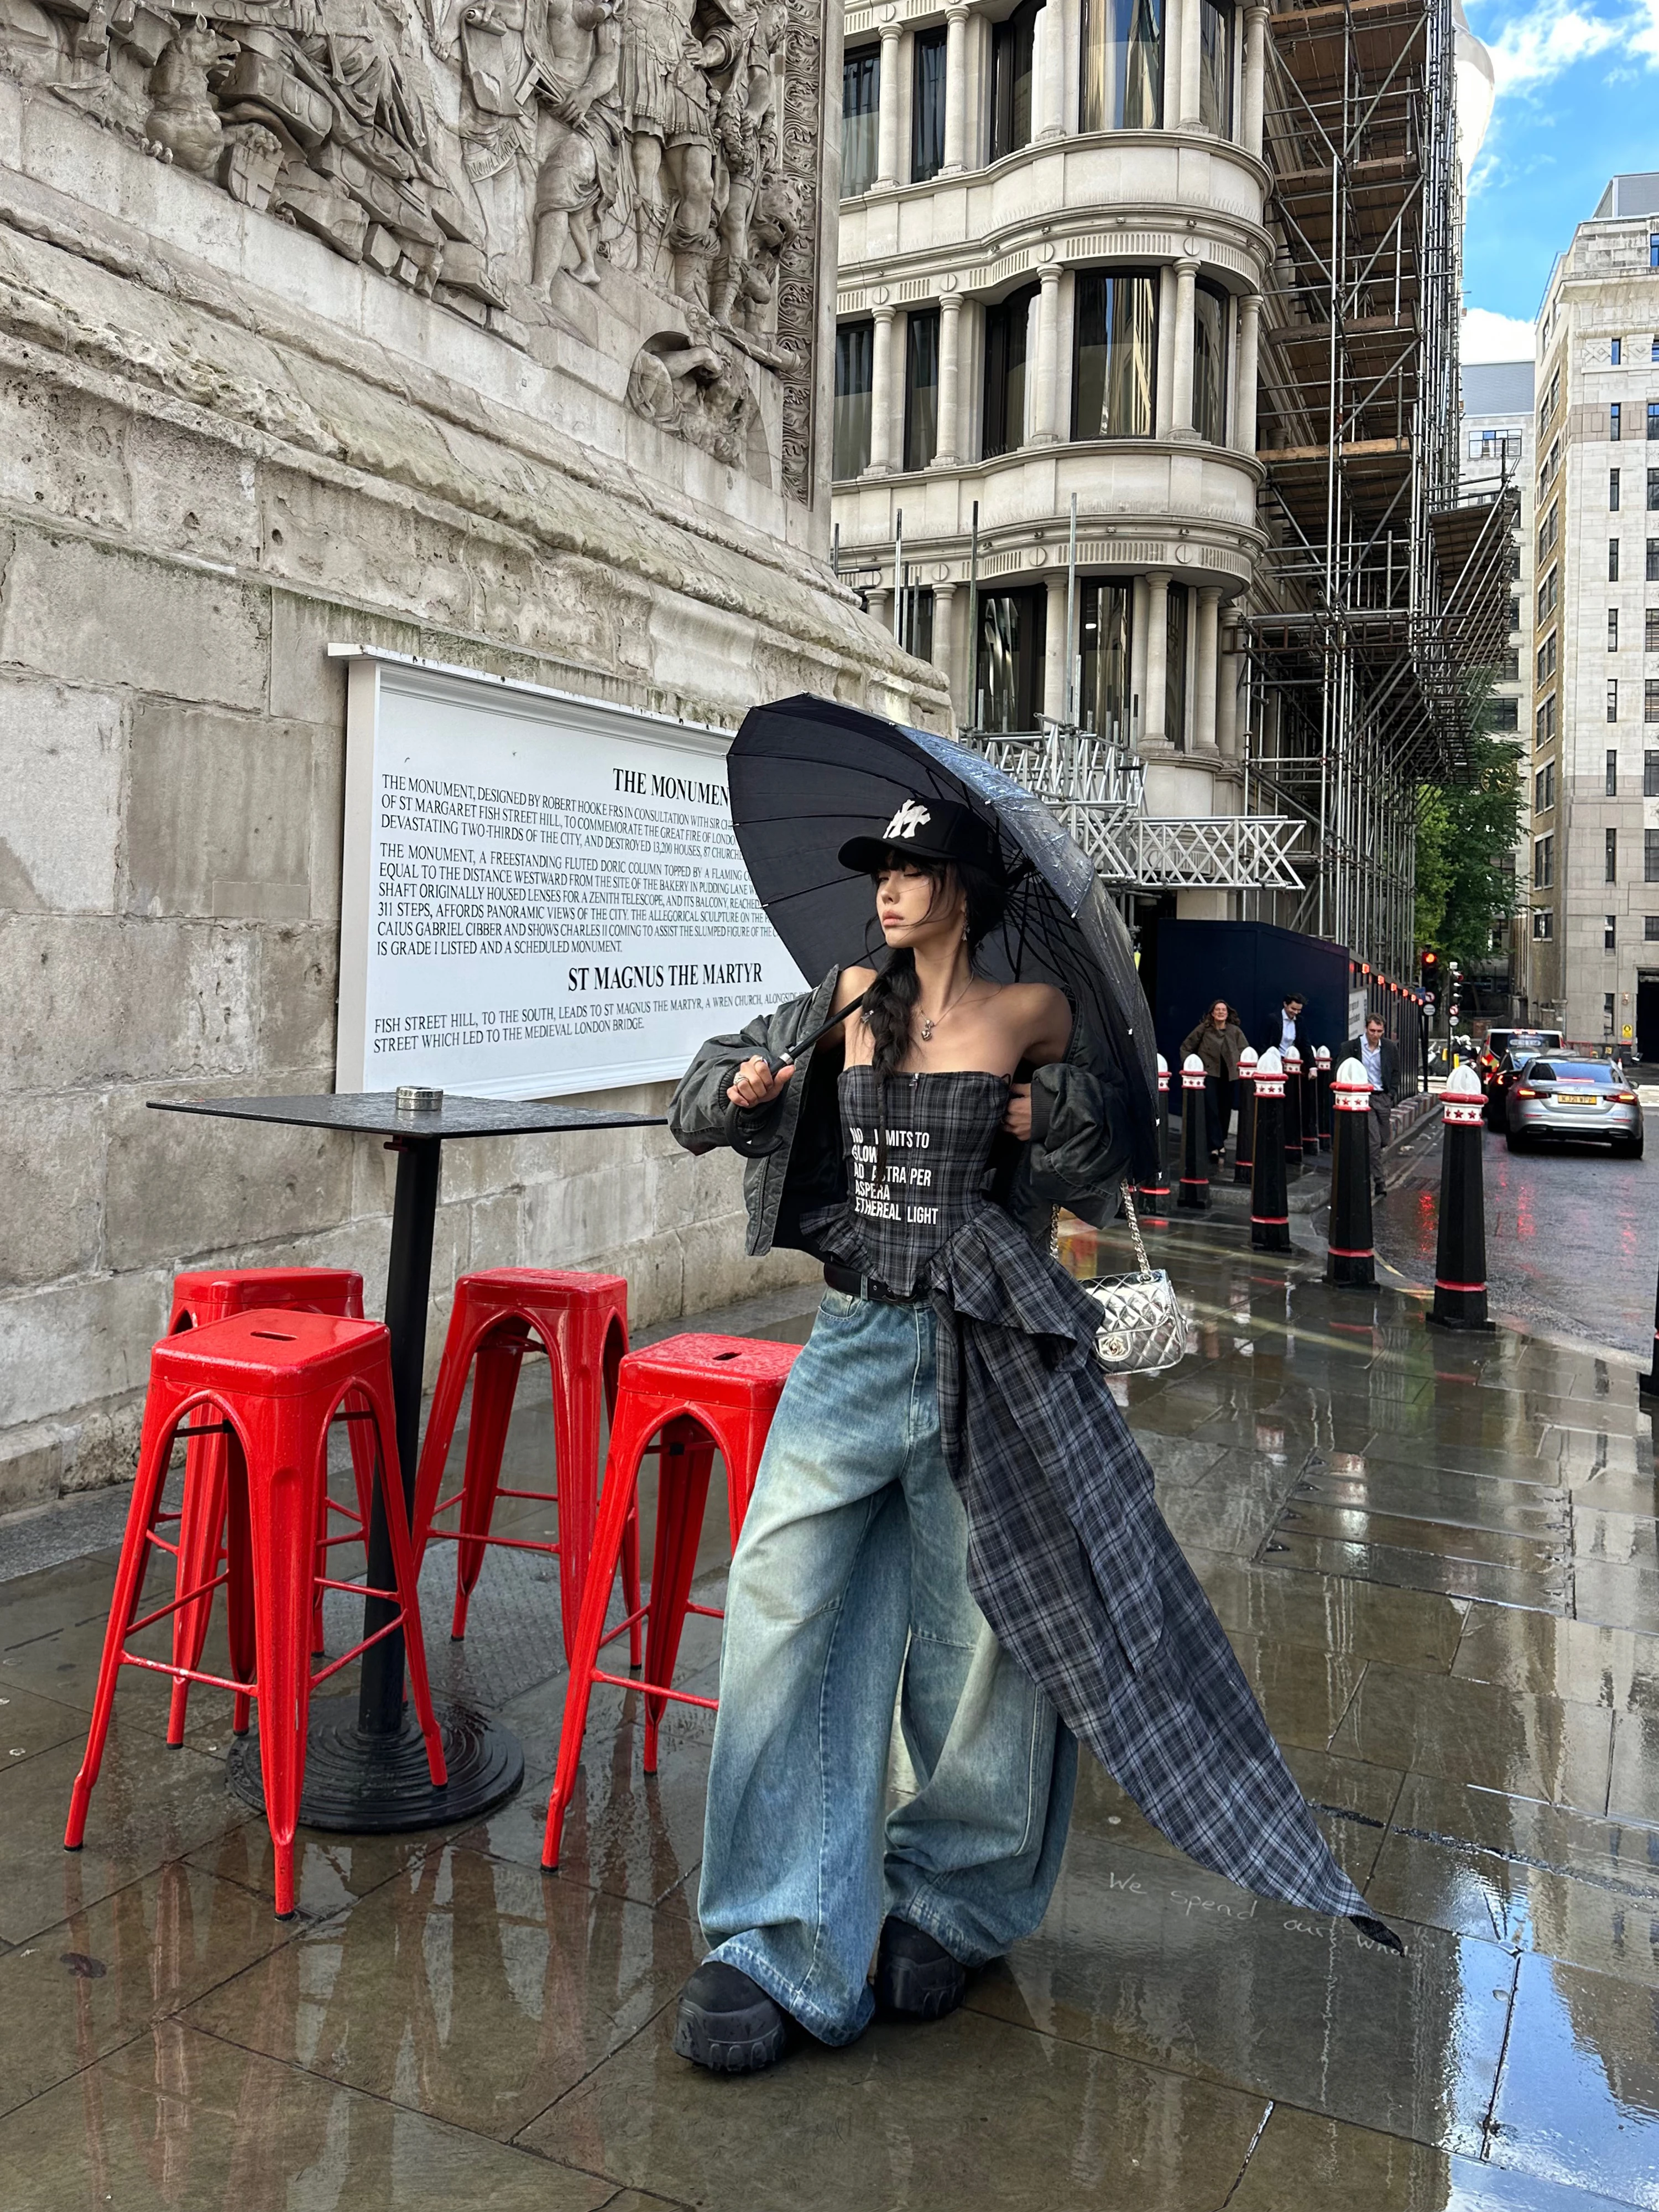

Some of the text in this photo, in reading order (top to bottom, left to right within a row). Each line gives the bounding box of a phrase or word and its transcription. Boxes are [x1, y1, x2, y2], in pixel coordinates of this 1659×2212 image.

[613, 769, 647, 795] THE
[382, 774, 406, 791] THE
[408, 777, 476, 801] MONUMENT,
[477, 786, 527, 805] DESIGNED
[528, 793, 540, 807] BY
[542, 795, 576, 811] ROBERT
[577, 799, 608, 815] HOOKE
[608, 803, 624, 817] FRS
[624, 805, 633, 818] IN
[634, 806, 689, 825] CONSULTATION
[690, 813, 709, 827] WITH
[709, 816, 720, 828] SIR
[381, 794, 737, 846] OF ST MARGARET FISH STREET HILL, TO COMMEMORATE THE GREAT FIRE OF LONDO
[381, 813, 458, 834] DEVASTATING
[461, 822, 524, 841] TWO-THIRDS
[525, 828, 538, 842] OF
[540, 830, 559, 843] THE
[560, 832, 582, 847] CITY,
[584, 834, 604, 848] AND
[604, 836, 651, 852] DESTROYED
[653, 841, 672, 855] 13,200
[674, 843, 702, 858] HOUSES,
[703, 846, 711, 857] 87
[379, 843, 404, 858] THE
[408, 845, 476, 865] MONUMENT,
[479, 851, 487, 864] A
[490, 852, 562, 869] FREESTANDING
[564, 857, 598, 871] FLUTED
[600, 860, 626, 873] DORIC
[628, 862, 662, 875] COLUMN
[664, 865, 691, 877] TOPPED
[692, 867, 702, 878] BY
[705, 868, 710, 878] A
[711, 868, 742, 880] FLAMING
[379, 862, 419, 880] EQUAL
[420, 865, 437, 879] TO
[438, 866, 461, 880] THE
[462, 867, 512, 883] DISTANCE
[514, 870, 568, 885] WESTWARD
[568, 874, 593, 887] FROM
[594, 875, 612, 888] THE
[612, 877, 630, 889] SITE
[630, 878, 641, 889] OF
[643, 878, 658, 890] THE
[659, 879, 688, 891] BAKERY
[690, 881, 698, 892] IN
[698, 881, 729, 894] PUDDING
[730, 884, 748, 895] LANE
[378, 883, 417, 898] SHAFT
[419, 884, 484, 900] ORIGINALLY
[487, 887, 526, 901] HOUSED
[528, 889, 561, 902] LENSES
[562, 890, 580, 903] FOR
[581, 891, 588, 903] A
[588, 891, 619, 904] ZENITH
[620, 893, 665, 907] TELESCOPE,
[666, 895, 683, 906] AND
[684, 896, 695, 907] ITS
[695, 896, 729, 910] BALCONY,
[377, 901, 393, 916] 311
[397, 902, 433, 919] STEPS,
[436, 903, 484, 918] AFFORDS
[487, 905, 545, 919] PANORAMIC
[546, 906, 575, 919] VIEWS
[577, 907, 588, 919] OF
[590, 907, 608, 920] THE
[608, 908, 629, 920] CITY.
[630, 909, 647, 920] THE
[648, 909, 699, 921] ALLEGORICAL
[700, 911, 739, 922] SCULPTURE
[740, 912, 750, 922] ON
[751, 912, 763, 922] THE
[377, 921, 413, 936] CAIUS
[415, 922, 464, 936] GABRIEL
[465, 923, 502, 936] CIBBER
[504, 924, 526, 936] AND
[527, 924, 559, 936] SHOWS
[560, 924, 601, 937] CHARLES
[602, 925, 607, 937] II
[608, 925, 641, 937] COMING
[642, 925, 654, 937] TO
[654, 925, 678, 937] ASSIST
[679, 926, 693, 937] THE
[694, 926, 727, 937] SLUMPED
[726, 926, 750, 937] FIGURE
[750, 927, 759, 937] OF
[760, 927, 772, 937] THE
[377, 941, 623, 956] IS GRADE I LISTED AND A SCHEDULED MONUMENT.
[567, 962, 762, 992] ST MAGNUS THE MARTYR
[374, 1017, 400, 1033] FISH
[404, 1014, 447, 1031] STREET
[450, 1012, 478, 1029] HILL,
[481, 1011, 496, 1025] TO
[498, 1010, 519, 1024] THE
[521, 1008, 556, 1024] SOUTH,
[559, 1005, 588, 1020] LEADS
[589, 1005, 602, 1018] TO
[604, 1004, 614, 1016] ST
[616, 1001, 651, 1015] MAGNUS
[654, 1001, 668, 1013] THE
[670, 999, 703, 1013] MARTYR,
[706, 998, 711, 1009] A
[712, 997, 733, 1008] WREN
[734, 995, 763, 1008] CHURCH,
[373, 1017, 644, 1053] STREET WHICH LED TO THE MEDIEVAL LONDON BRIDGE.
[849, 1128, 863, 1144] NO
[915, 1131, 930, 1149] TO
[852, 1145, 878, 1163] GLOW
[854, 1162, 865, 1181] AD
[910, 1168, 932, 1187] PER
[855, 1180, 890, 1201] ASPERA
[854, 1197, 939, 1225] ETHEREAL LIGHT
[1108, 1871, 1147, 1895] We
[1170, 1887, 1258, 1921] spend
[1283, 1918, 1331, 1938] our
